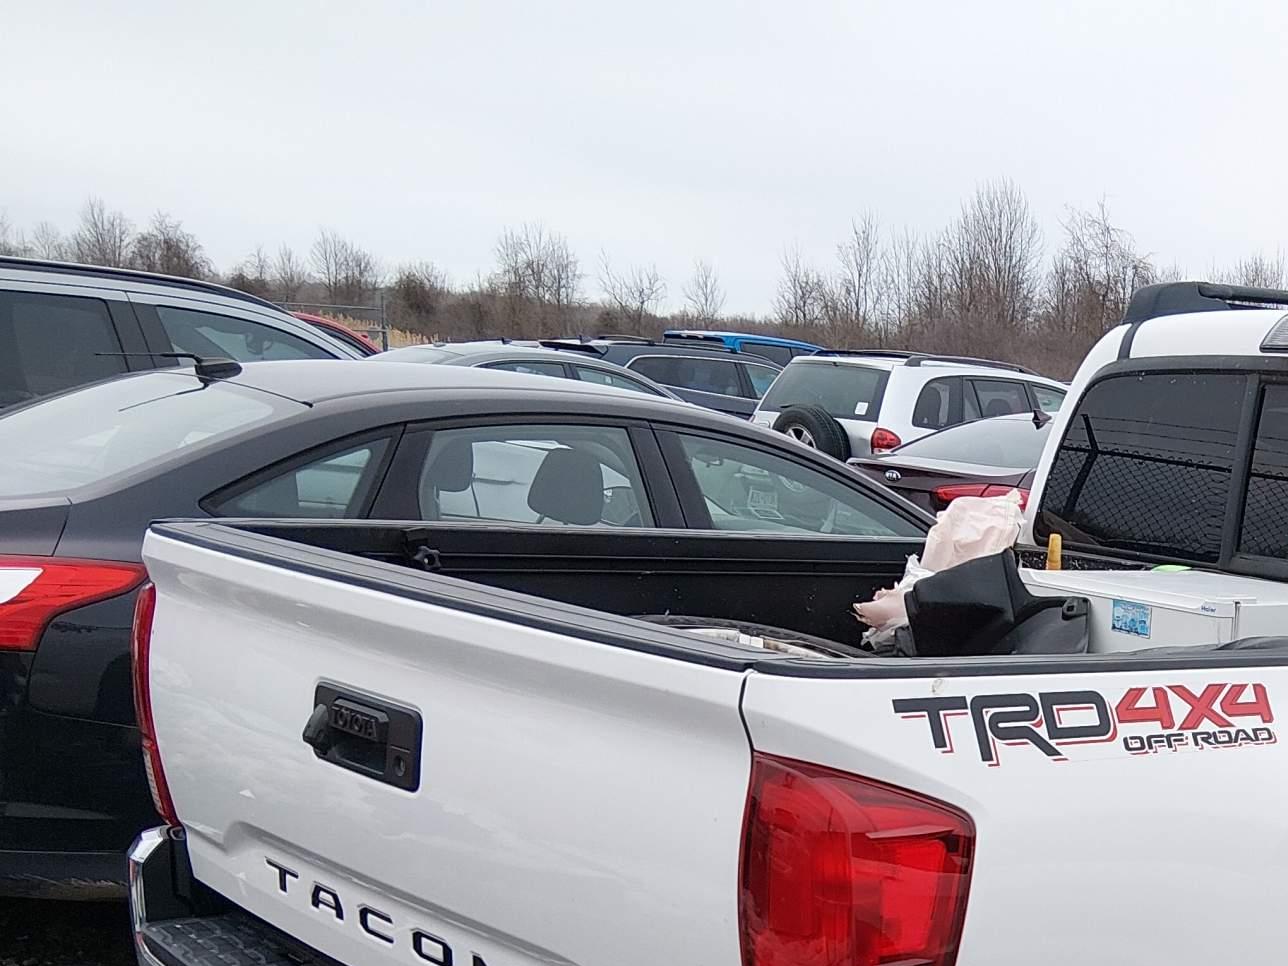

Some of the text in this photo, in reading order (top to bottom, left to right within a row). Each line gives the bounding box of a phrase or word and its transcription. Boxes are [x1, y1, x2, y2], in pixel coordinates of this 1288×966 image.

[331, 705, 377, 738] TOYOTA
[892, 690, 1117, 766] TRD
[1123, 727, 1276, 754] OFF ROAD
